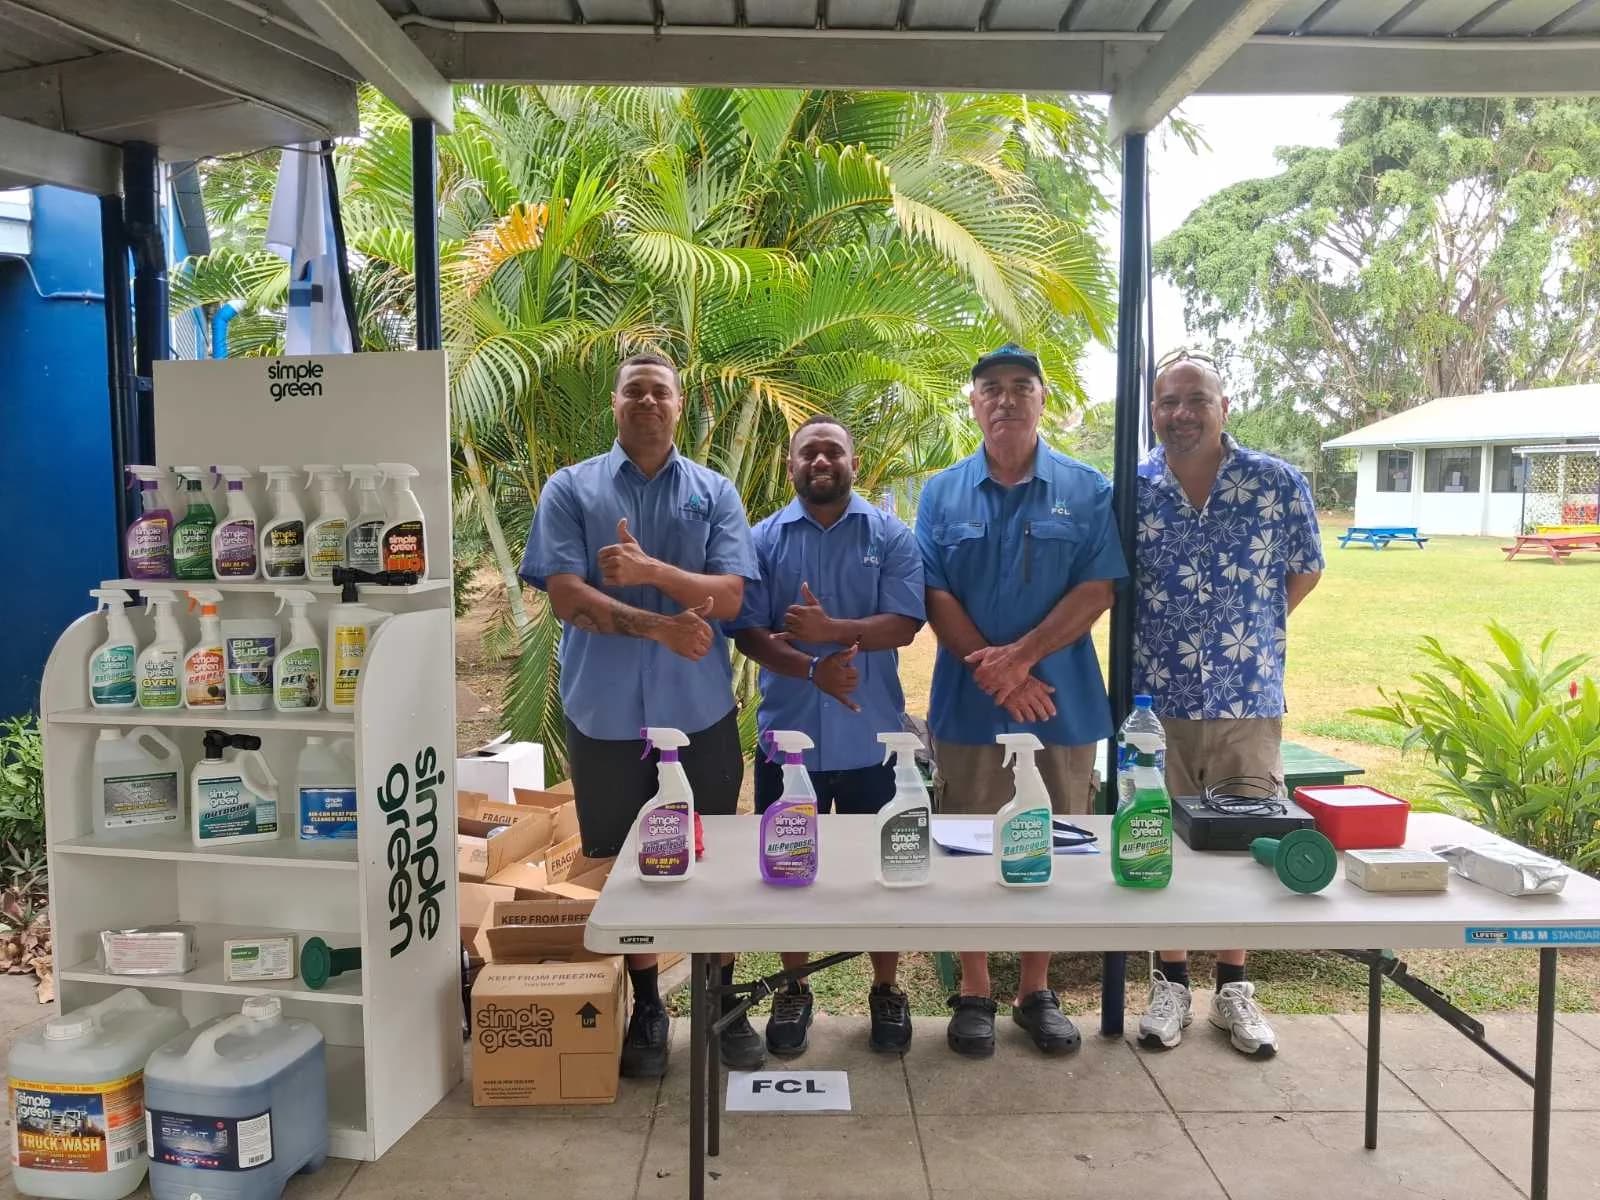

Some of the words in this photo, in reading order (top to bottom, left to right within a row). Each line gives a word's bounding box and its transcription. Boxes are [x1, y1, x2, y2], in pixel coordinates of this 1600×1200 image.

[268, 360, 324, 383] simple
[270, 382, 323, 402] green
[1050, 507, 1071, 516] FCL
[142, 679, 176, 688] OVEN
[648, 814, 680, 828] simple
[775, 815, 806, 827] simple
[1010, 819, 1042, 831] simple
[1130, 816, 1163, 829] simple
[648, 825, 679, 836] green
[775, 825, 806, 837] green
[1011, 829, 1042, 841] green
[1132, 827, 1162, 840] green
[411, 746, 446, 942] simple
[891, 832, 920, 843] simple
[892, 842, 920, 853] green
[377, 762, 413, 959] green
[501, 915, 527, 926] KEEP
[528, 914, 559, 925] FROM
[561, 914, 590, 924] FREE
[1514, 930, 1535, 940] 1.83
[1538, 930, 1548, 940] M
[1552, 930, 1600, 941] STANDAR
[551, 972, 606, 980] FREEZING
[477, 1003, 554, 1032] simple
[479, 1028, 553, 1054] green
[752, 1079, 826, 1094] FCL
[19, 1092, 51, 1109] simple
[19, 1106, 51, 1119] green
[21, 1133, 58, 1151] TRUCK
[60, 1136, 101, 1152] WASH
